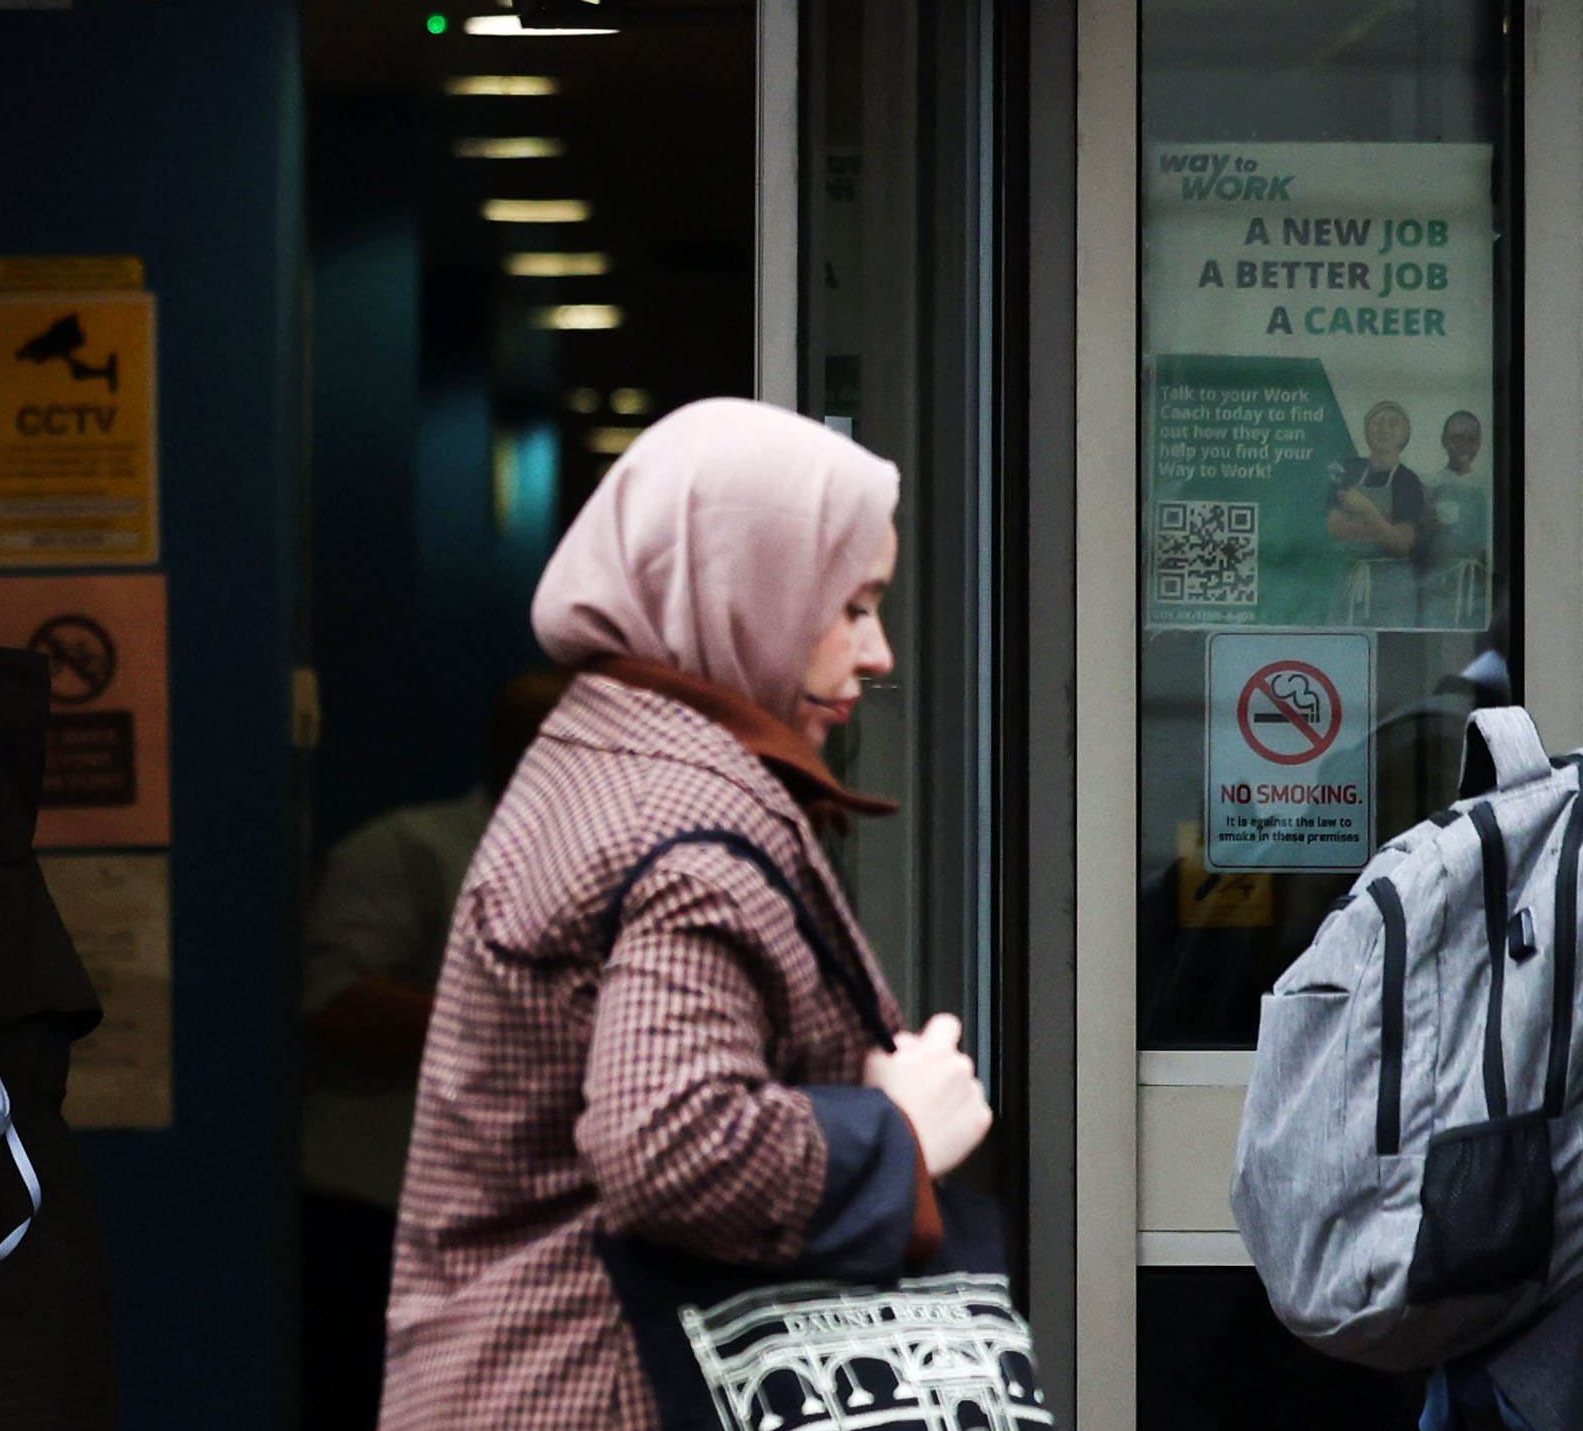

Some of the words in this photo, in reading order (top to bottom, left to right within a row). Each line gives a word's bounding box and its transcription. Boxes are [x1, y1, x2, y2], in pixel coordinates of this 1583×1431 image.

[1158, 153, 1230, 179] way
[1234, 156, 1257, 172] to
[1182, 174, 1296, 202] WORK
[1244, 217, 1270, 246] A
[1283, 218, 1371, 247] NEW
[1379, 219, 1448, 255] JOB
[1198, 260, 1224, 288] A
[1236, 260, 1371, 290] BETTER
[1379, 261, 1448, 298] JOB
[1266, 306, 1293, 335] A
[1304, 307, 1446, 337] CAREER
[1160, 386, 1195, 401] Talk
[1199, 388, 1216, 401] to
[1219, 389, 1258, 405] your
[1264, 387, 1310, 402] Work
[15, 404, 118, 435] CCTV
[1160, 405, 1211, 421] Coach
[1215, 406, 1266, 425] today
[1268, 408, 1285, 422] to
[1289, 406, 1324, 422] find
[1160, 424, 1189, 438] out
[1193, 424, 1227, 439] how
[1232, 425, 1270, 445] they
[1274, 428, 1305, 441] can
[1158, 442, 1196, 461] help
[1200, 445, 1231, 461] you
[1235, 443, 1268, 459] find
[1274, 446, 1313, 463] your
[1158, 462, 1195, 480] Way
[1200, 465, 1217, 477] to
[1221, 463, 1272, 479] Work!
[1221, 784, 1251, 804] NO
[1256, 784, 1363, 804] SMOKING.
[1226, 816, 1236, 827] It
[1237, 816, 1247, 827] is
[1250, 816, 1292, 831] against
[1296, 816, 1315, 827] the
[1317, 816, 1337, 827] law
[1339, 817, 1352, 827] to
[1219, 831, 1256, 842] smoke
[1258, 831, 1269, 842] in
[1272, 831, 1305, 842] these
[1307, 832, 1360, 845] premises
